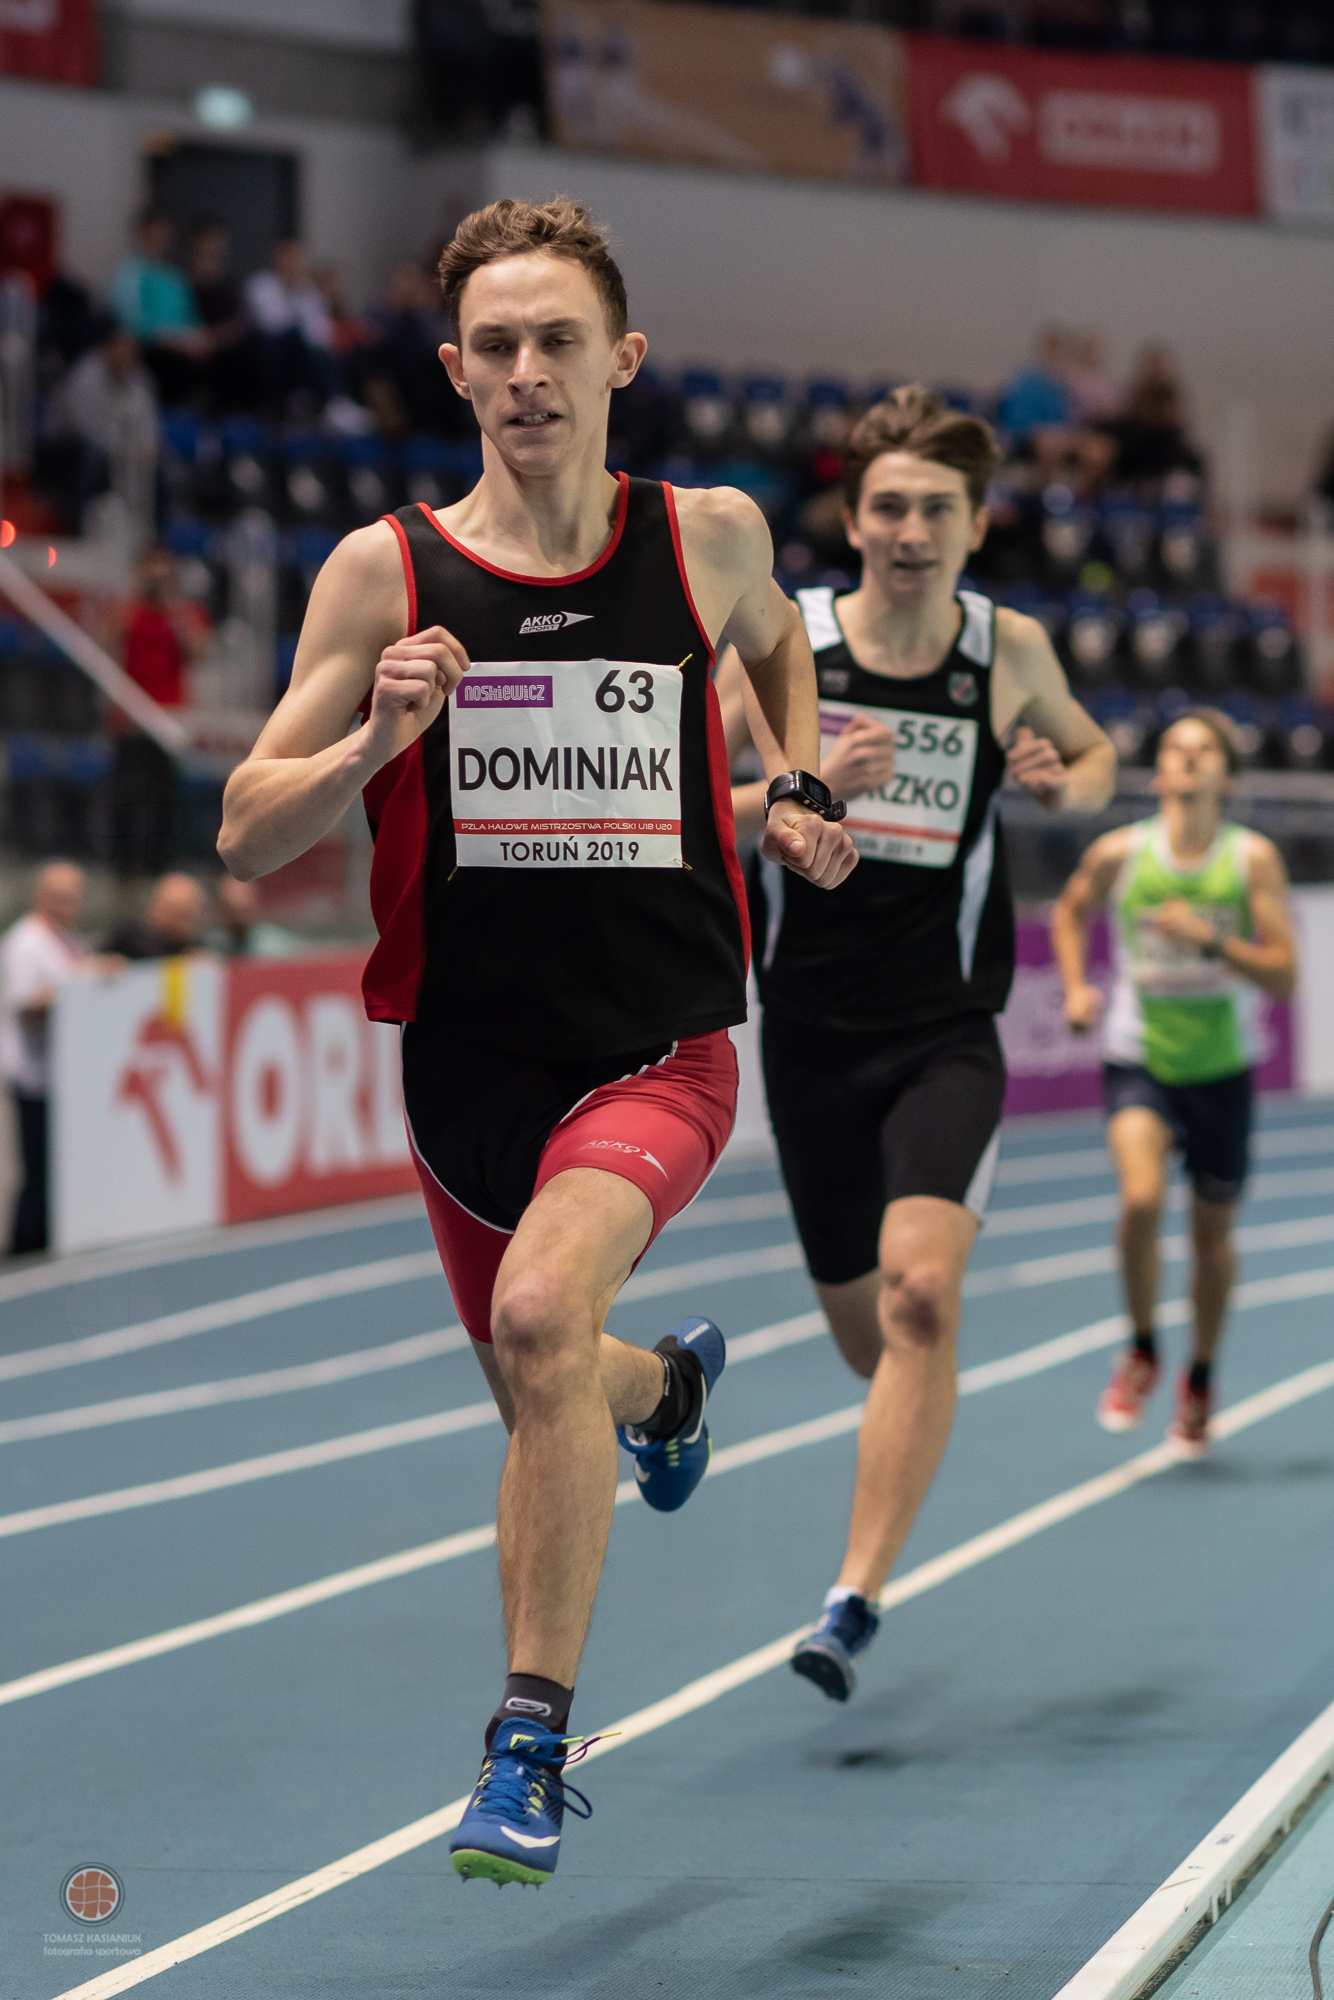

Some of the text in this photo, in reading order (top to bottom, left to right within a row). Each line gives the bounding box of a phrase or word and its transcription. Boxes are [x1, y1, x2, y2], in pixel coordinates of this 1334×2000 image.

[521, 614, 563, 628] AKKO
[595, 669, 654, 713] 63
[895, 719, 963, 757] 556
[457, 746, 673, 791] DOMINIAK
[655, 823, 673, 831] U20
[500, 836, 639, 861] TORUŃ 2019
